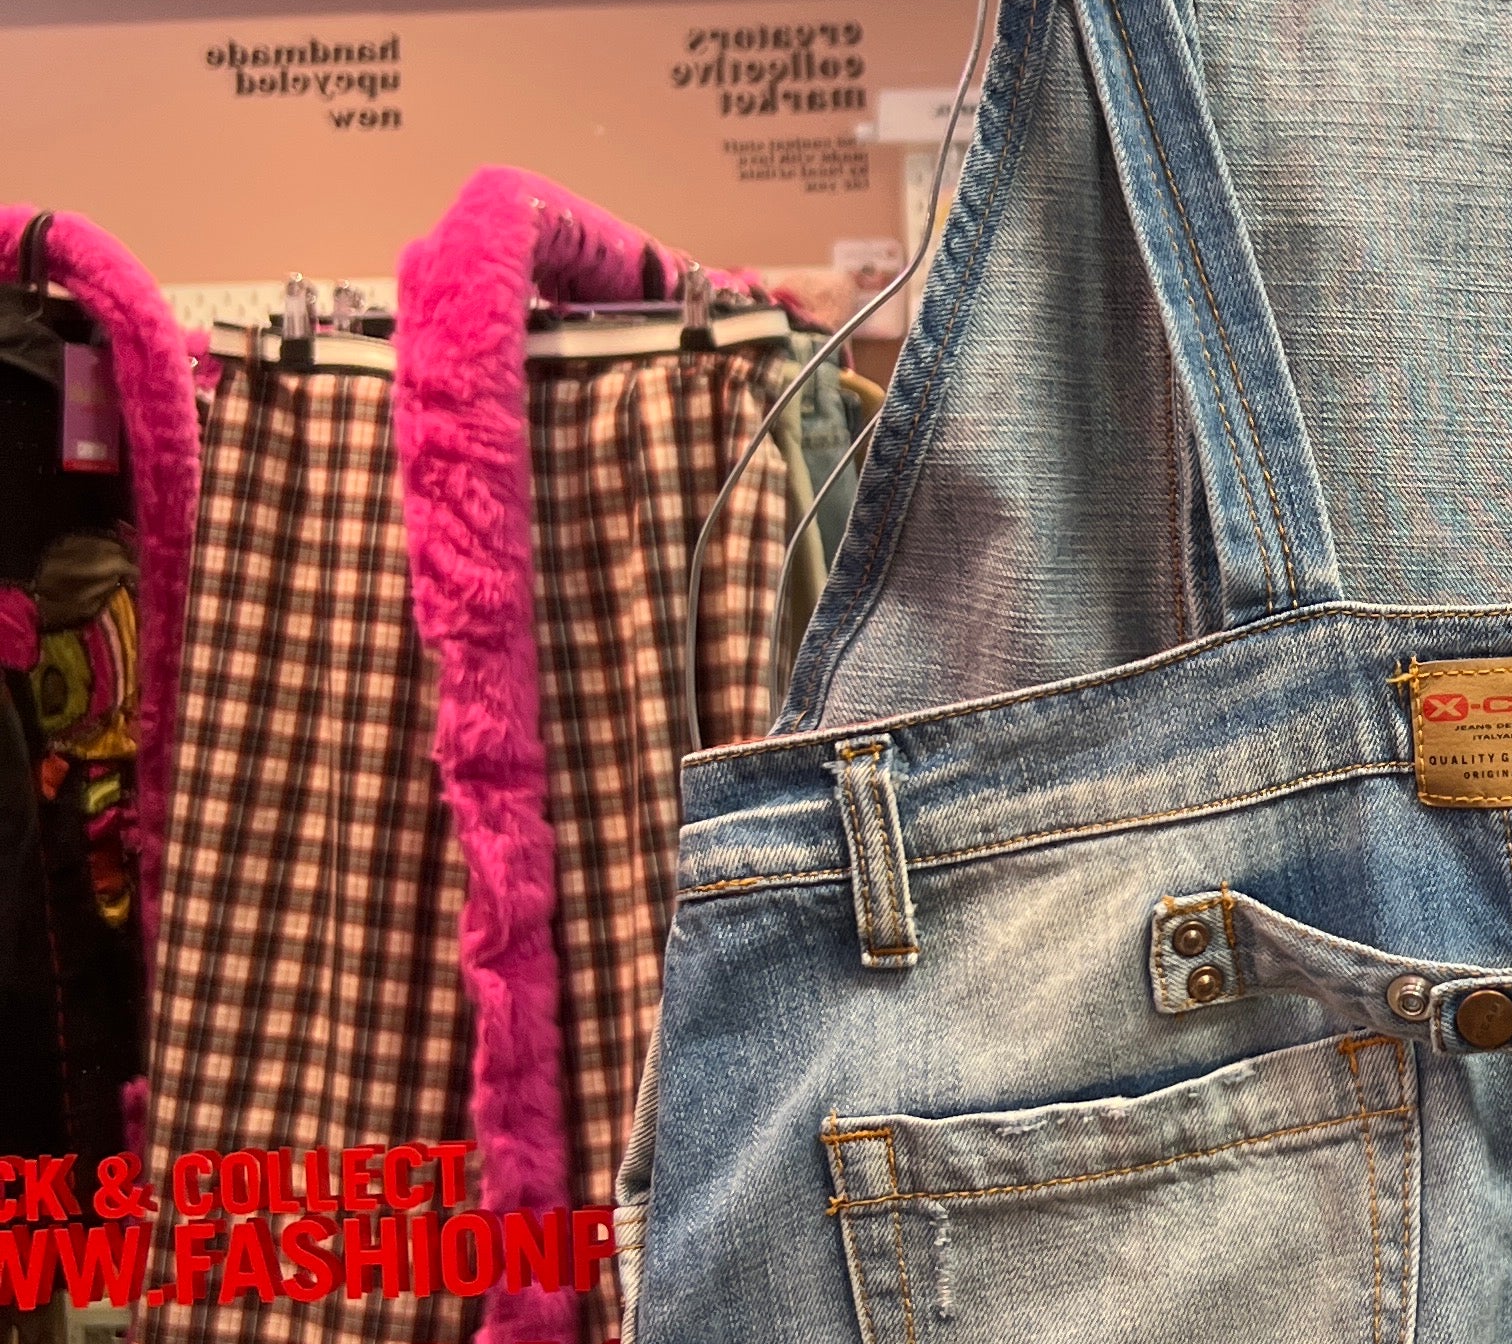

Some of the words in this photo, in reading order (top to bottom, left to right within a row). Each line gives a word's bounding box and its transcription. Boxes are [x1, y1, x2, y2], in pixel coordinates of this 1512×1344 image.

[1454, 723, 1492, 732] JEANS
[1428, 752, 1495, 766] QUALITY
[93, 1153, 156, 1219] &
[173, 1142, 475, 1218] COLLECT
